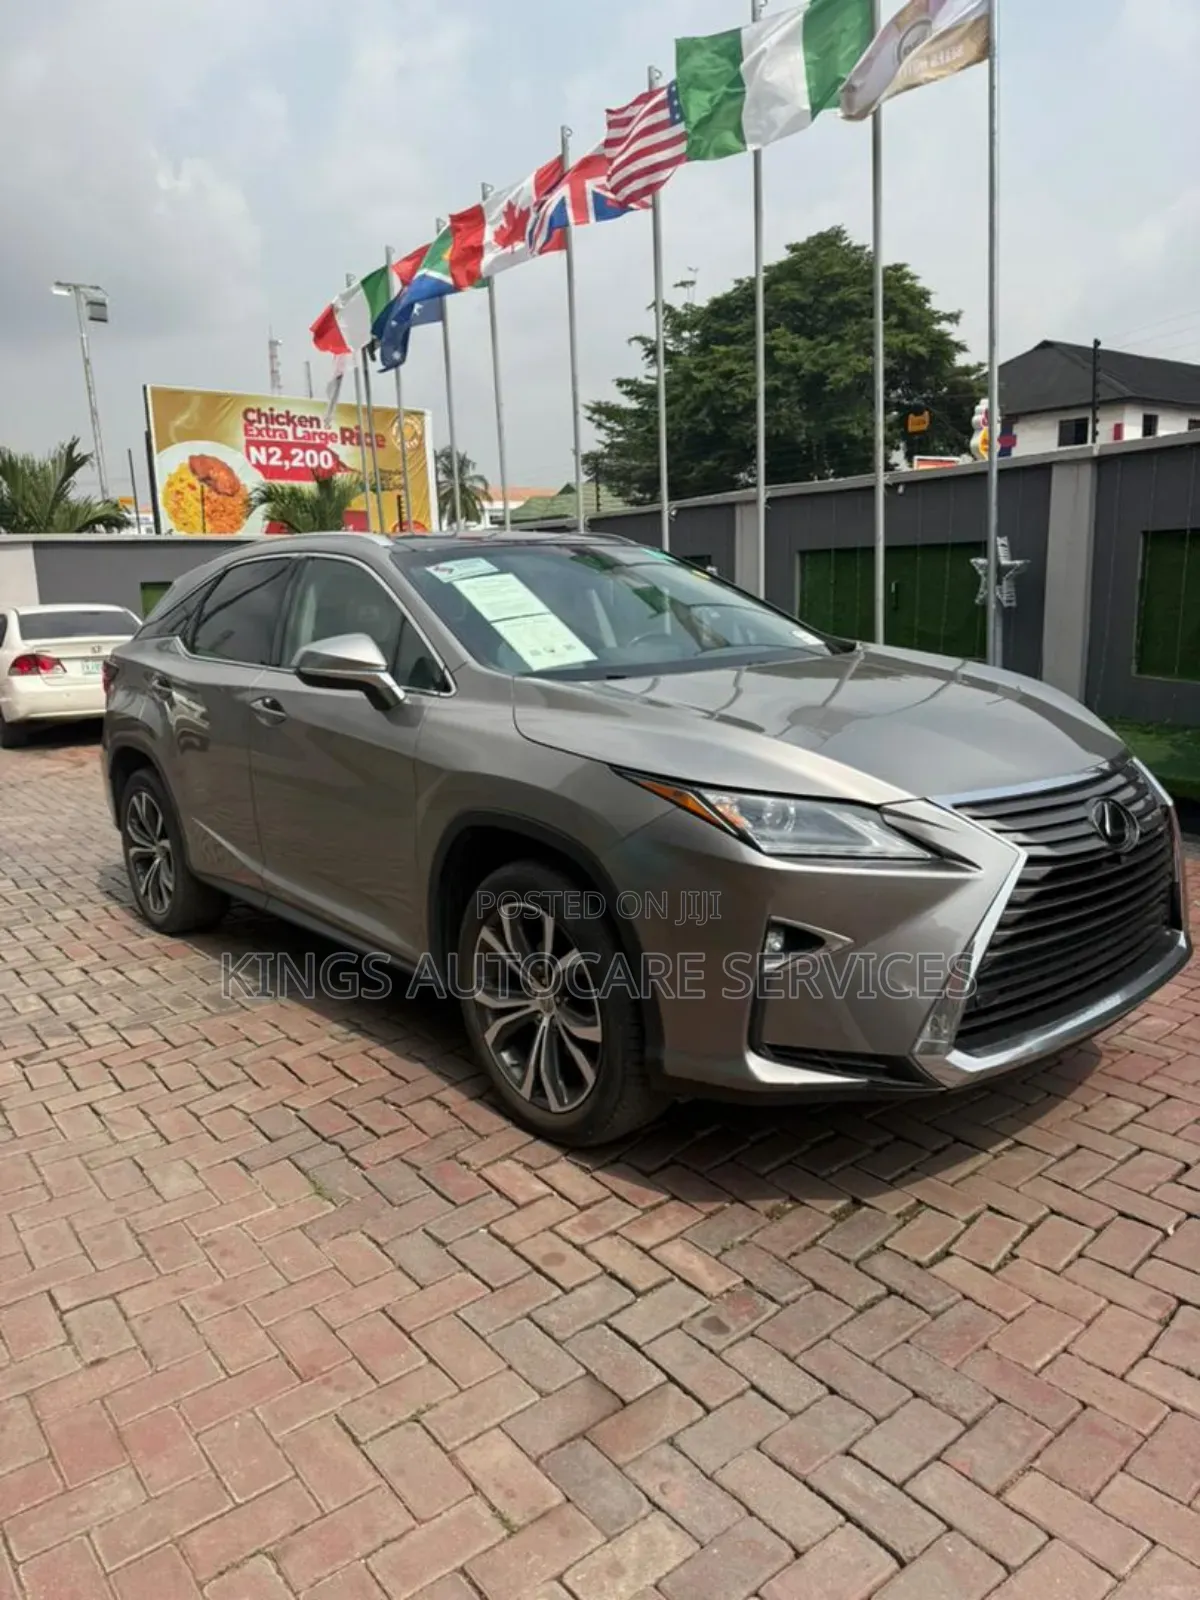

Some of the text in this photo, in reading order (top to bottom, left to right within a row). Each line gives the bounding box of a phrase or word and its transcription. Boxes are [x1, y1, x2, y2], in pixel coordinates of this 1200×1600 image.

[243, 407, 321, 429] Chicken
[244, 422, 288, 439] Extra
[292, 424, 339, 445] Large
[249, 446, 334, 471] N2,200
